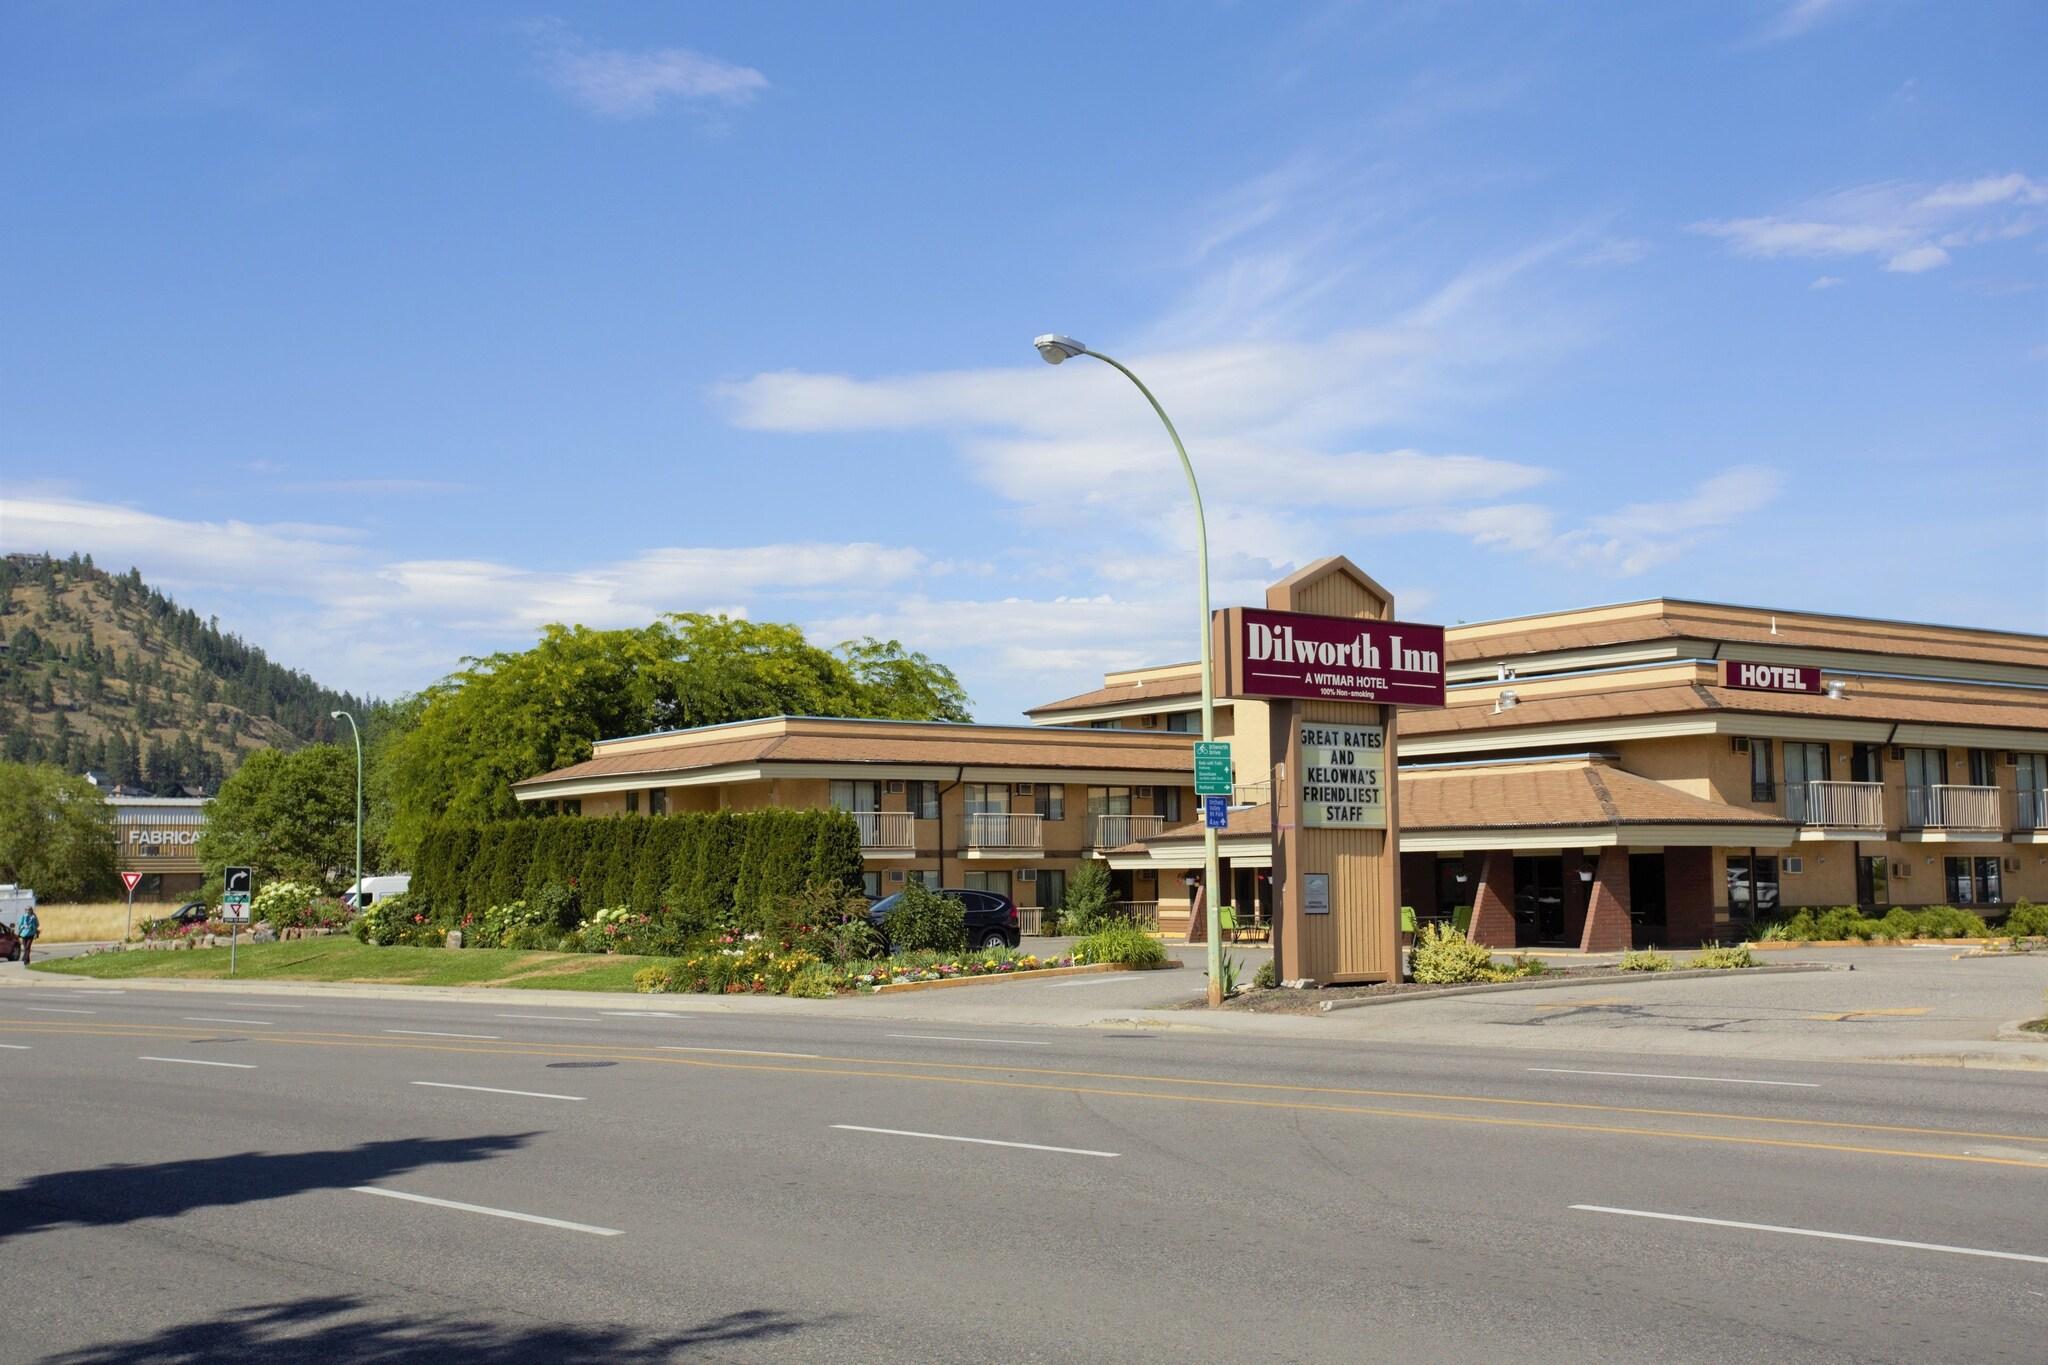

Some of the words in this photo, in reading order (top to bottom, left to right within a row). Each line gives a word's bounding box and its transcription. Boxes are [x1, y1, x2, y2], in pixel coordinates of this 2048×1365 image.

[1247, 623, 1381, 669] Dilworth
[1389, 635, 1440, 674] Inn
[1305, 672, 1313, 684] A
[1314, 673, 1354, 687] WITMAR
[1356, 676, 1389, 690] HOTEL
[1741, 664, 1807, 690] HOTEL
[1320, 688, 1336, 696] 100%
[1301, 729, 1339, 746] GREAT
[1344, 732, 1381, 748] RATES
[1331, 750, 1355, 765] AND
[1307, 767, 1376, 785] KELOWNA'S
[1303, 786, 1379, 803] FRIENDLIEST
[1326, 806, 1363, 821] STAFF
[129, 831, 207, 845] FABRICA
